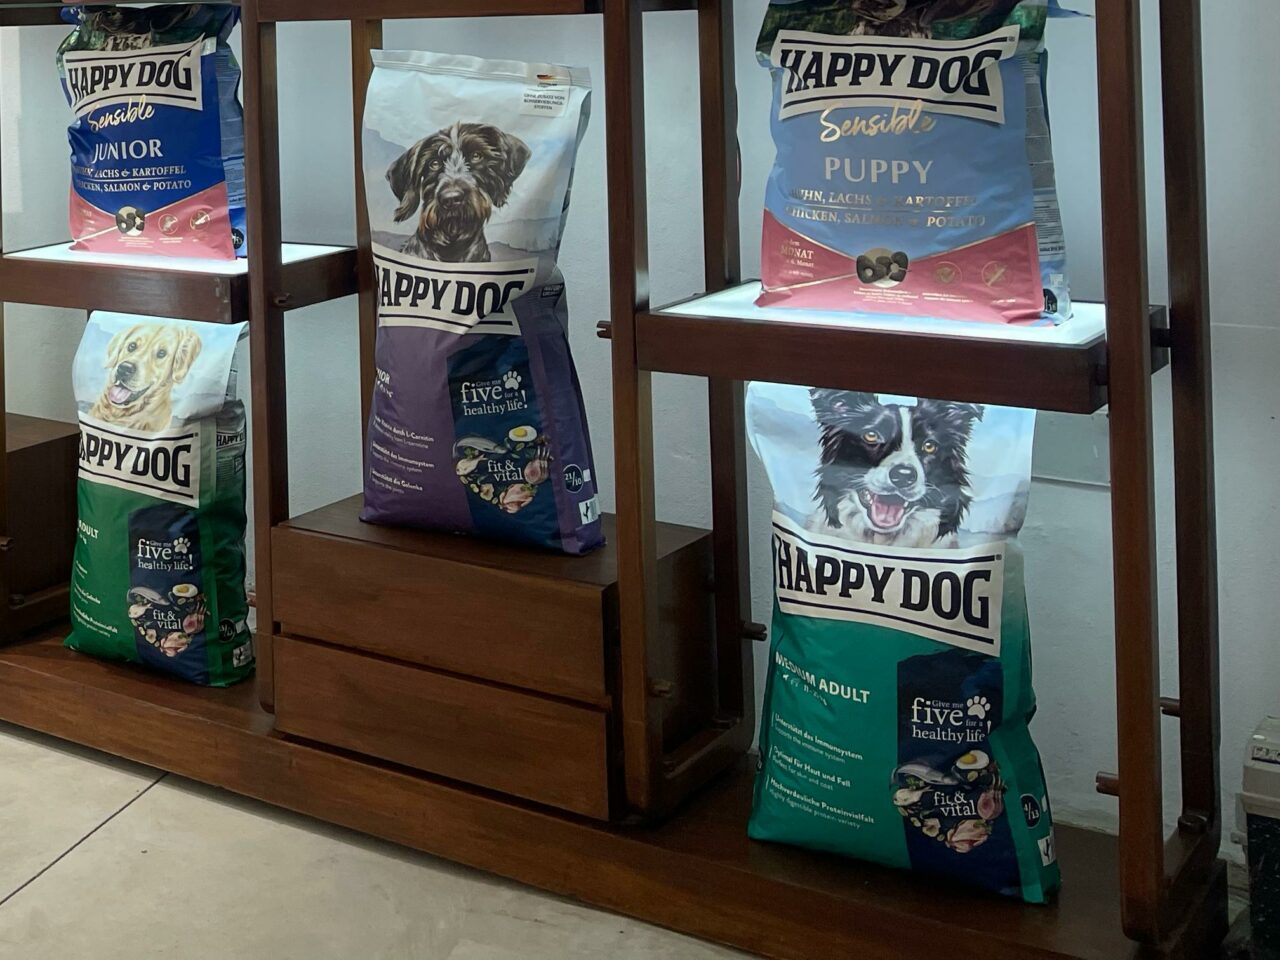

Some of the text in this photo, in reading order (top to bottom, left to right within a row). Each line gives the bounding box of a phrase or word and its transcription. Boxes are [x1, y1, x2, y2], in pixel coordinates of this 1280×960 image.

[68, 54, 193, 107] HAPPY DOG
[780, 48, 1002, 97] HAPPY DOG
[88, 94, 155, 133] Sensible
[820, 99, 937, 143] Sensible
[92, 139, 163, 164] JUNIOR
[132, 165, 186, 177] KARTOFFEL
[824, 156, 933, 184] PUPPY
[104, 180, 191, 192] SALMON POTATO
[829, 190, 871, 204] LACHS
[780, 245, 815, 260] MONAT
[375, 264, 451, 311] APPY
[460, 382, 502, 404] five
[464, 404, 505, 416] healthy
[130, 444, 191, 488] DOG
[488, 460, 502, 472] fit
[494, 468, 524, 481] vital
[78, 520, 99, 539] ADULT
[137, 538, 172, 559] five
[138, 559, 173, 572] healthy
[775, 533, 992, 629] HAPPY DOG
[153, 609, 165, 620] fit
[157, 619, 182, 629] vital
[775, 651, 816, 687] MEDIUM
[819, 678, 870, 704] ADULT
[911, 697, 963, 726] five
[932, 700, 950, 708] Give
[912, 725, 965, 744] healthy
[934, 791, 950, 806] fit
[940, 800, 977, 817] vital
